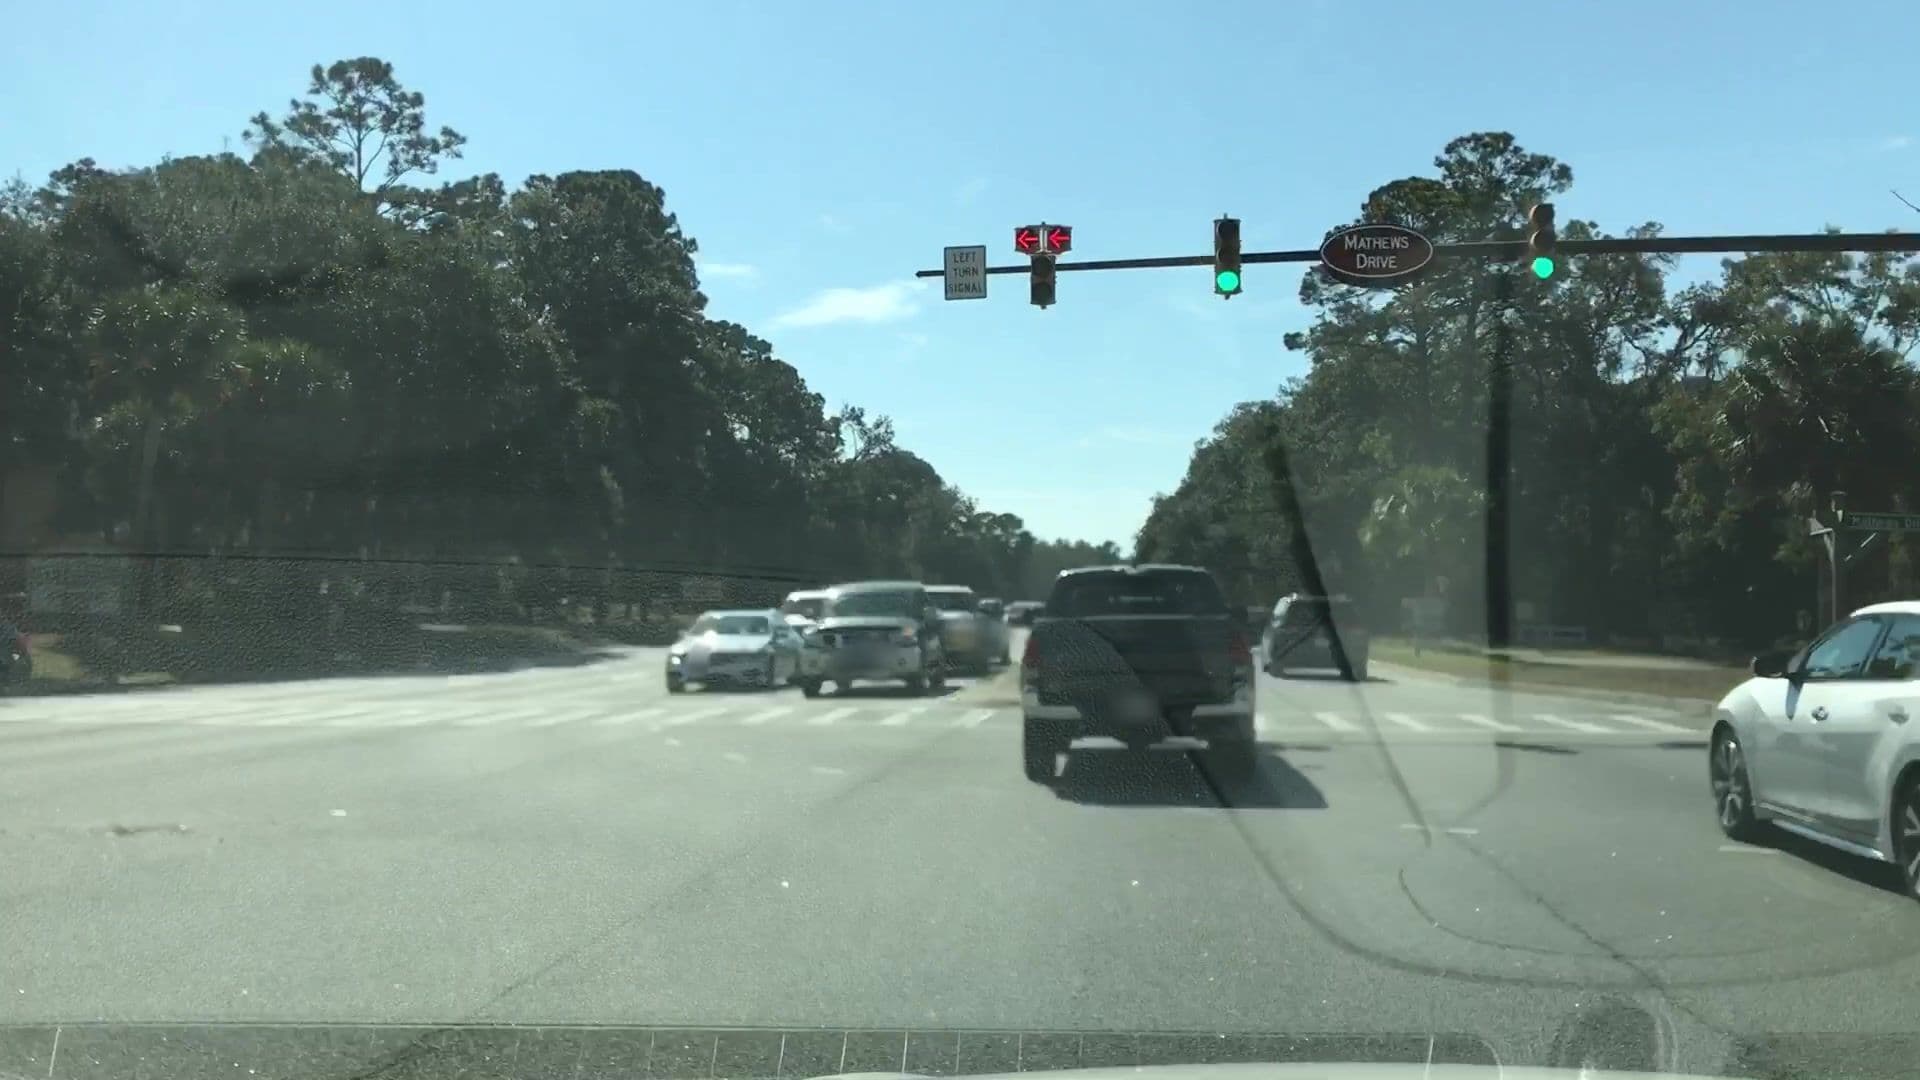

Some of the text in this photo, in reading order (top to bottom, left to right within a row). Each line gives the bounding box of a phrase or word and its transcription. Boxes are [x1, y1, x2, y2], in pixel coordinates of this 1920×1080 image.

[1344, 234, 1410, 251] MATHEWS
[953, 251, 976, 263] LEFT
[1356, 253, 1398, 269] DRIVE
[953, 266, 979, 278] TURN
[948, 281, 983, 295] SIGNAL
